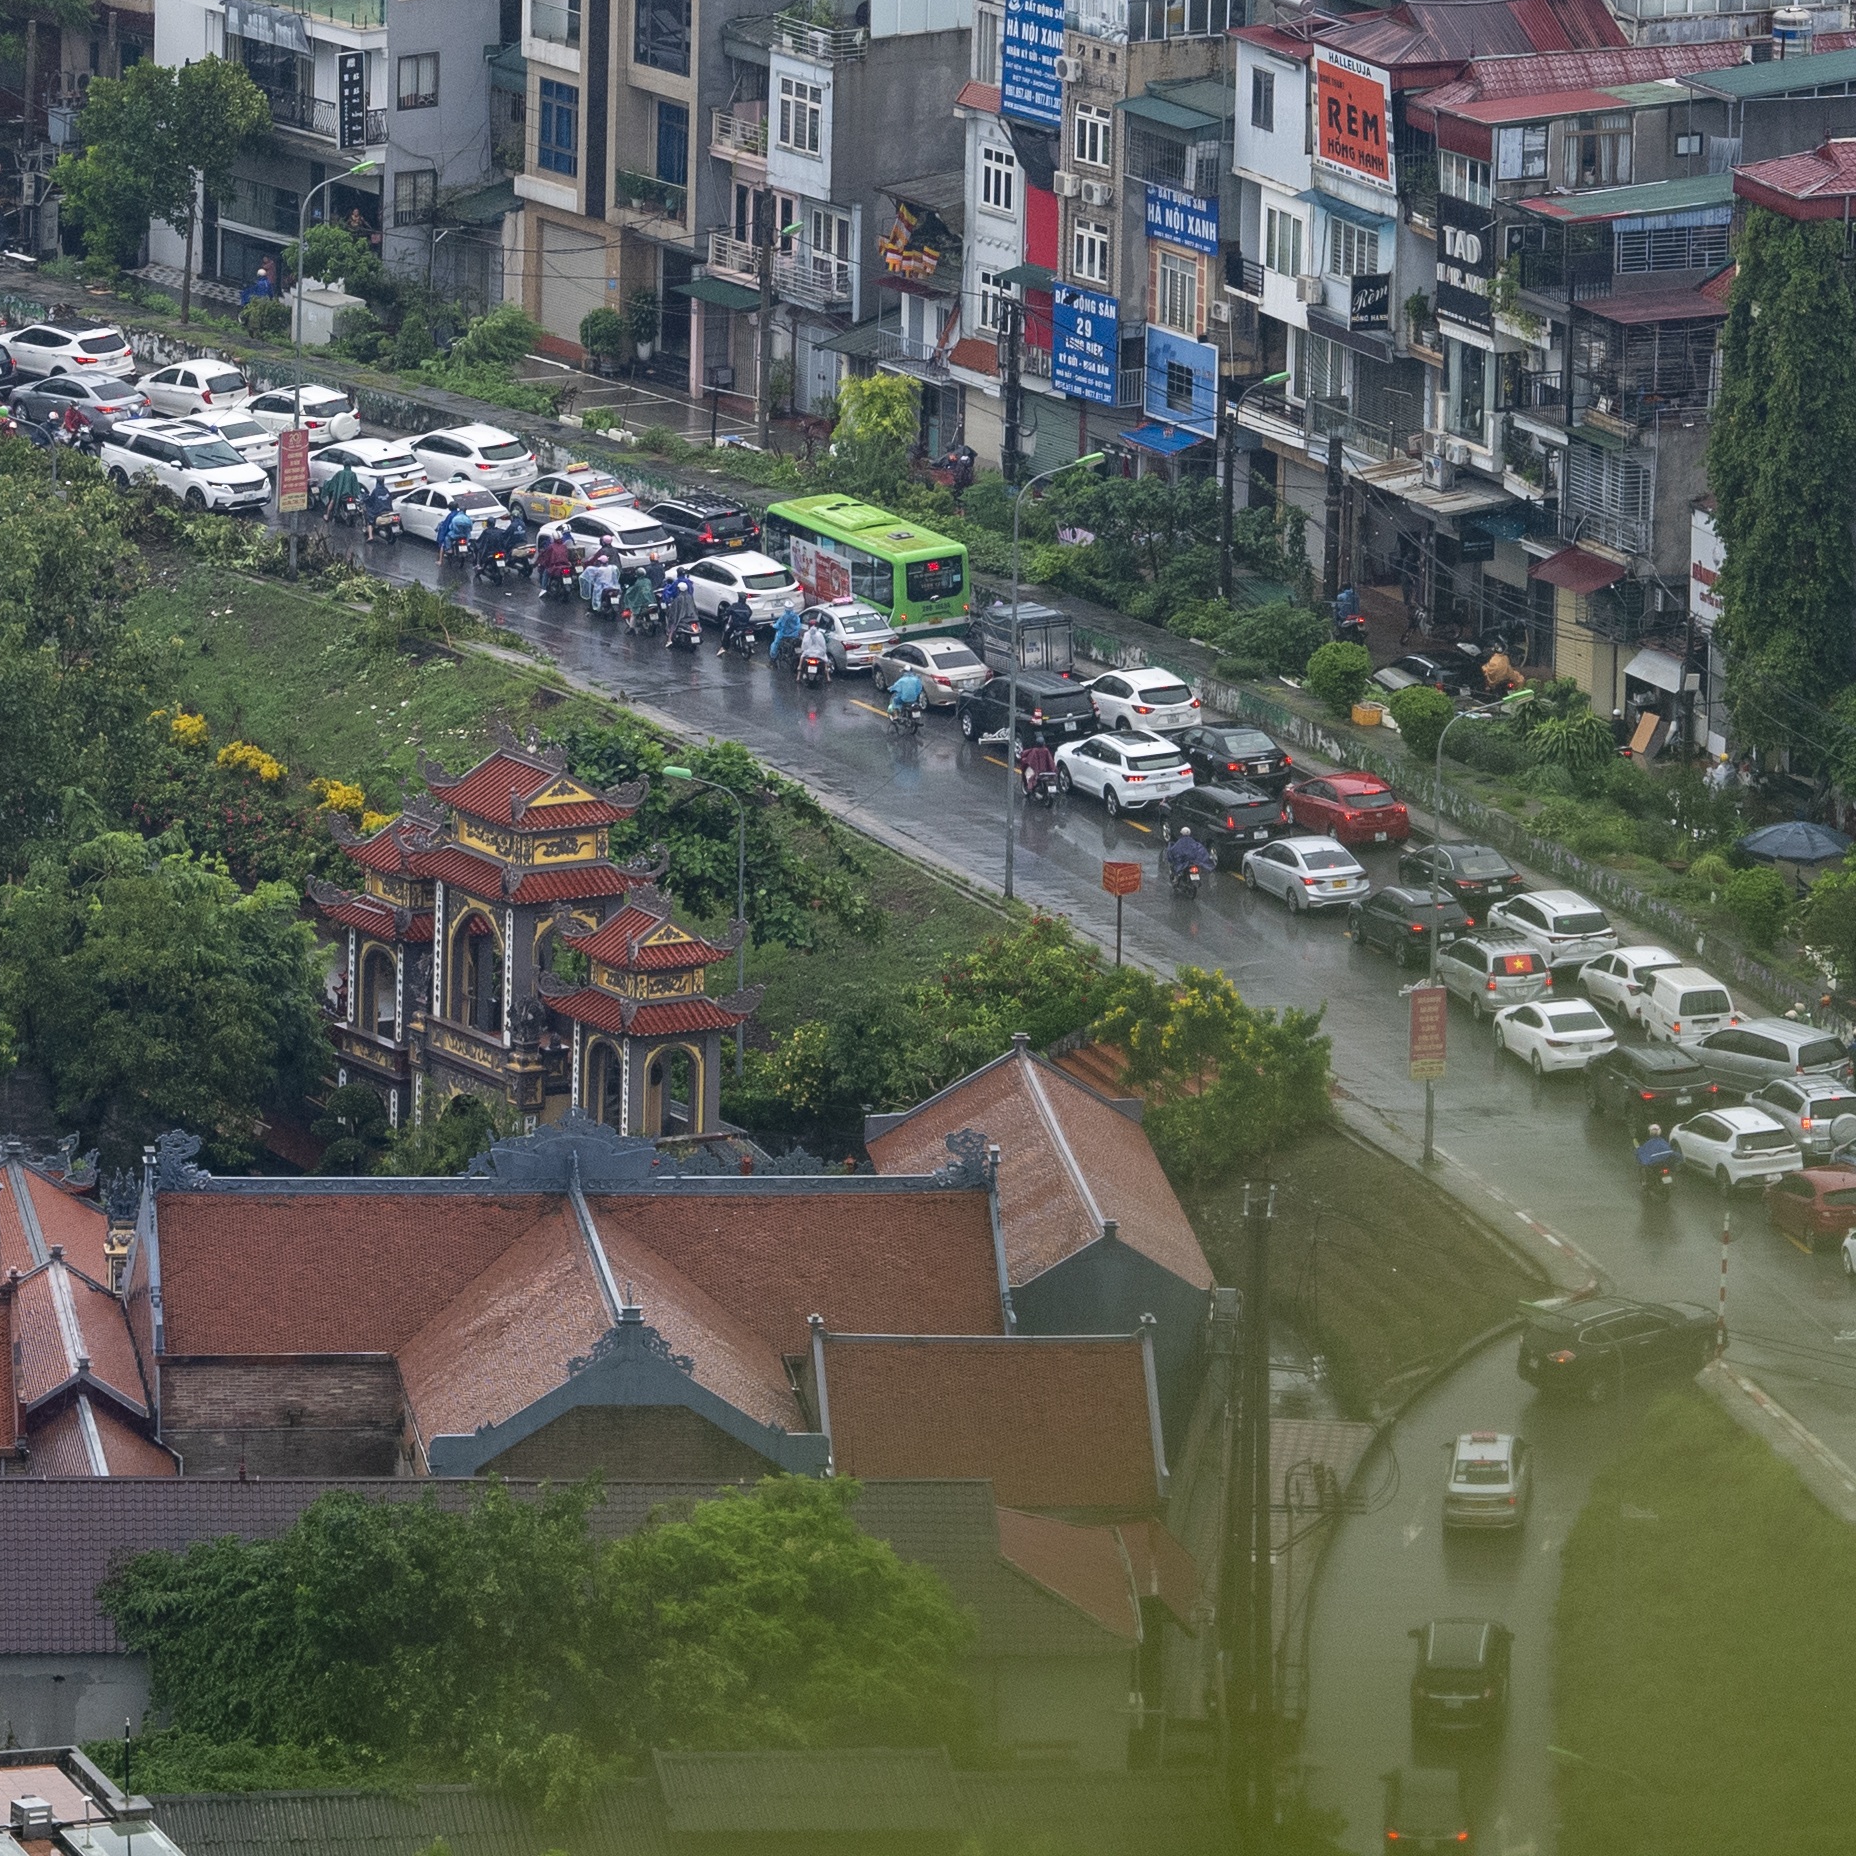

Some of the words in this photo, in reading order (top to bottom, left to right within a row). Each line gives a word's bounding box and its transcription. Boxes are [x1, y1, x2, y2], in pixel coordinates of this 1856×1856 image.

[1007, 16, 1019, 38] HÀ
[1022, 21, 1038, 45] NỘI
[1329, 51, 1372, 78] HALLELUJA
[1327, 92, 1380, 146] RÈM
[1147, 201, 1162, 225] HÀ
[1165, 206, 1184, 234] NỘI
[1187, 214, 1217, 242] XANH
[1443, 225, 1483, 264] TAD
[1073, 294, 1096, 314] ĐỘNG
[1098, 300, 1116, 320] SẢN
[1352, 285, 1388, 313] Rèm
[1076, 317, 1092, 338] 29
